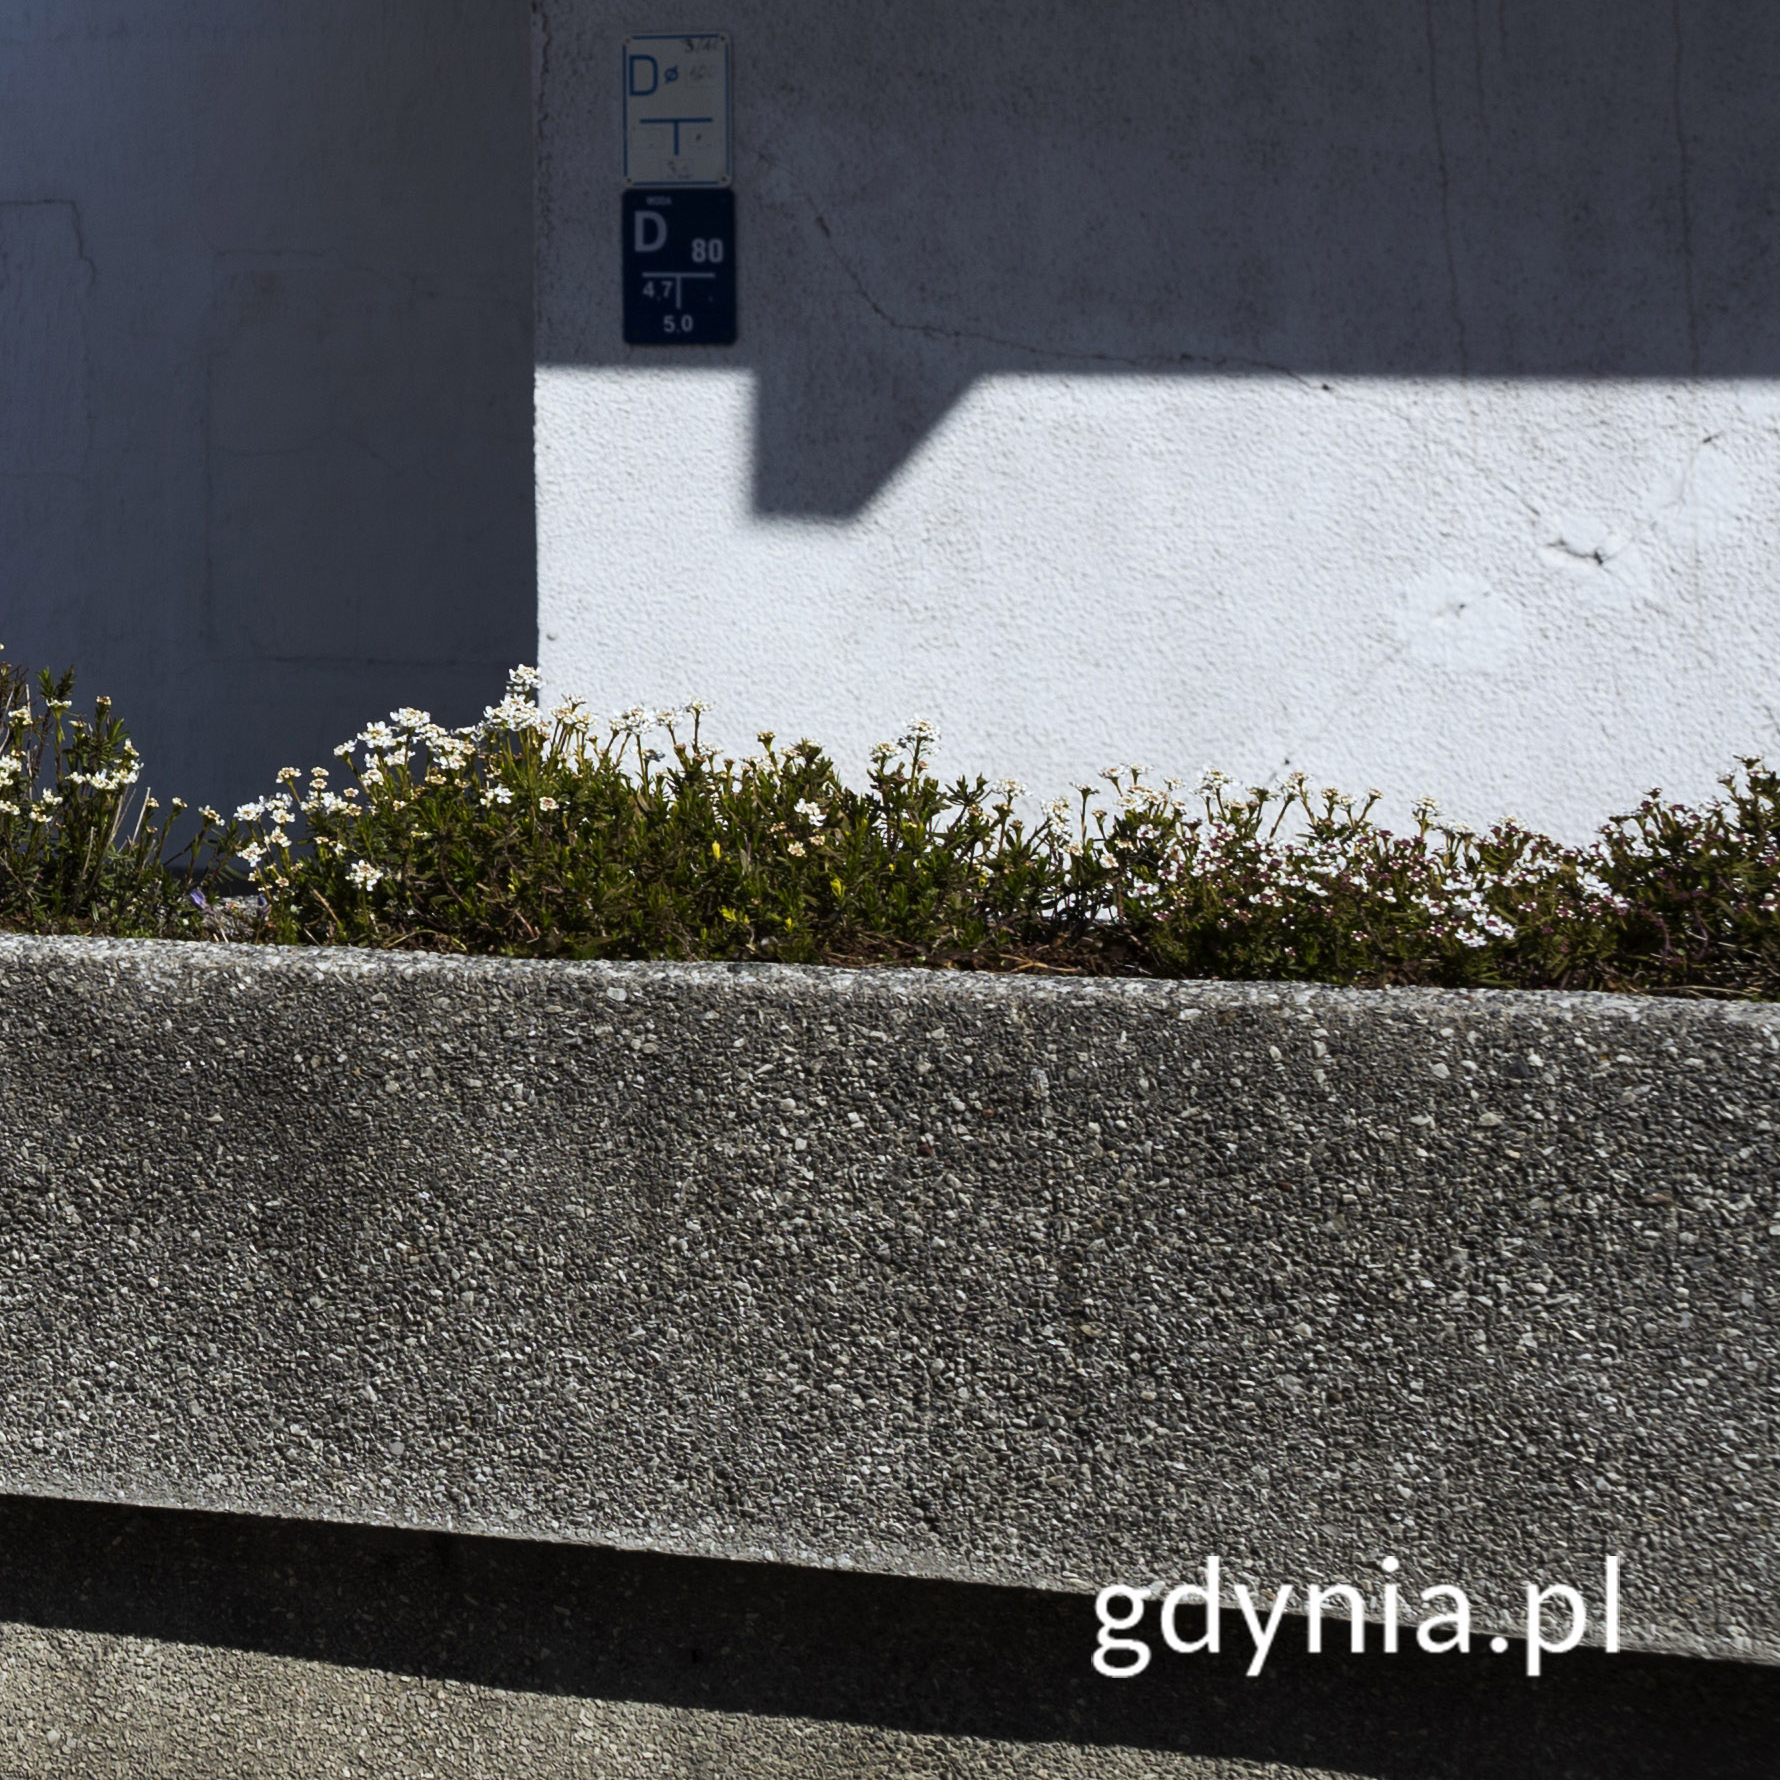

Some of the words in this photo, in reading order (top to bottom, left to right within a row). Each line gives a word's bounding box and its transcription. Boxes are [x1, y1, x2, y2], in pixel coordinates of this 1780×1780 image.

[628, 54, 659, 97] D
[634, 210, 669, 253] D
[691, 237, 725, 264] 80
